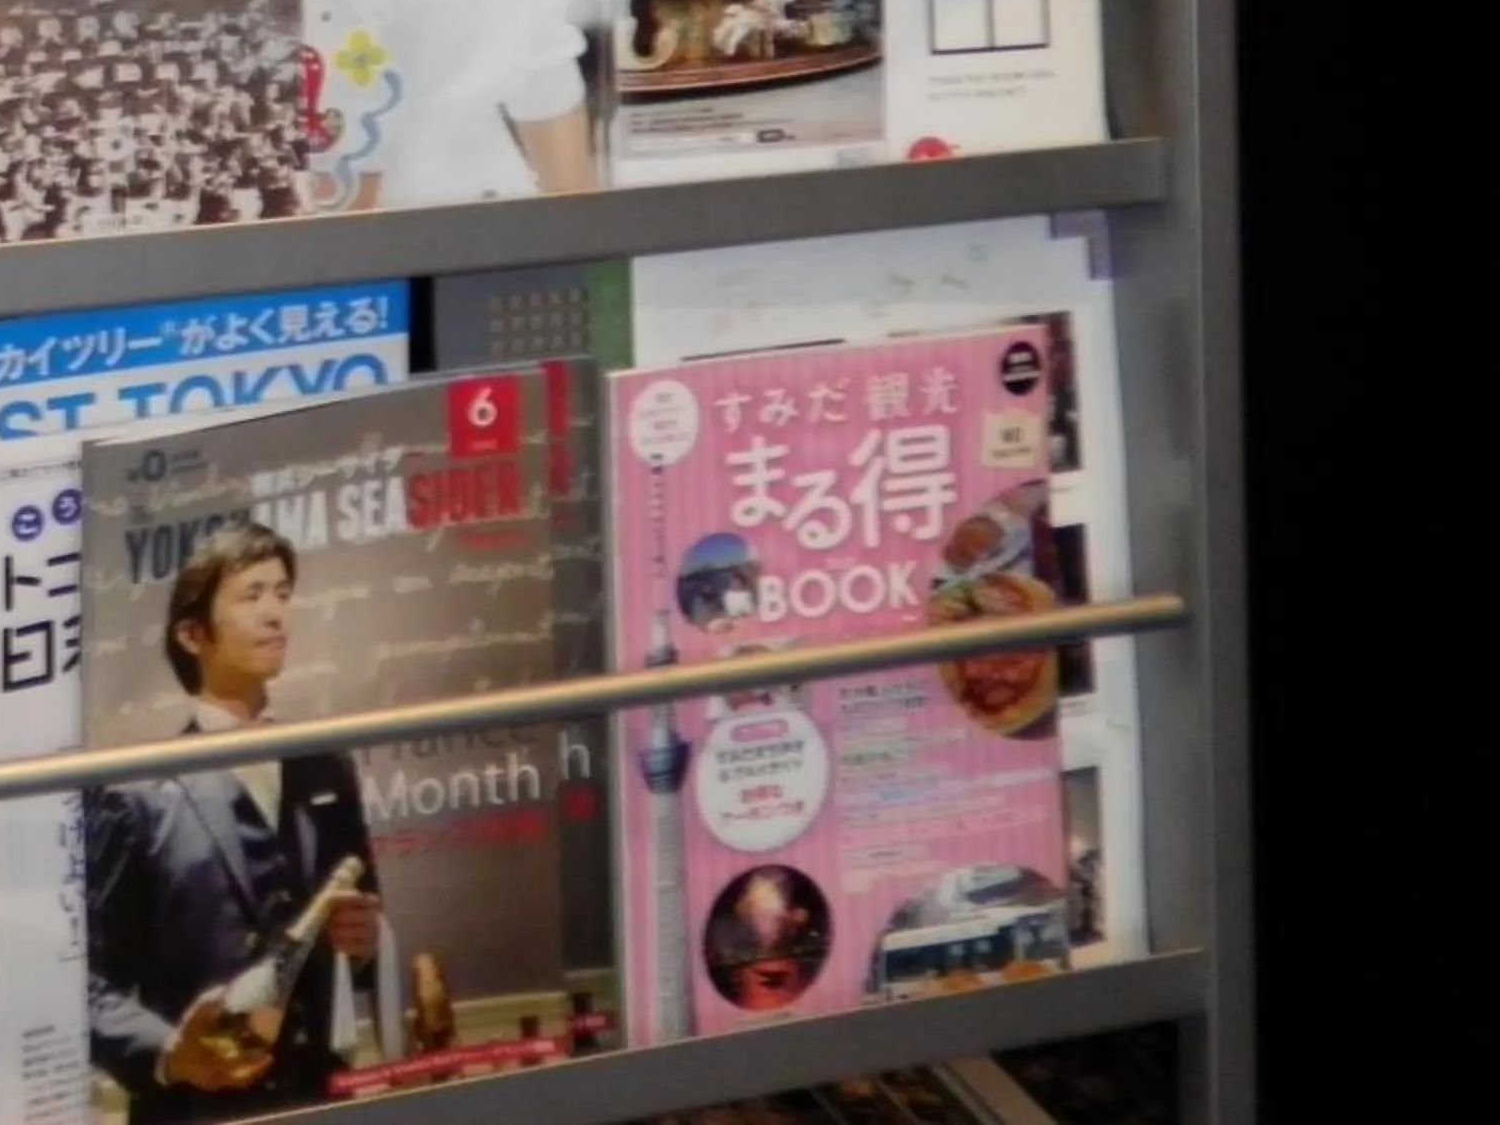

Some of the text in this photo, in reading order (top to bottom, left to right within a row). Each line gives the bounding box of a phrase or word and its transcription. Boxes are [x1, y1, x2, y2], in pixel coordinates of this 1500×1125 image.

[467, 386, 498, 427] 6
[723, 424, 957, 550] まる得
[758, 560, 921, 622] BOOK
[360, 750, 541, 825] Month
